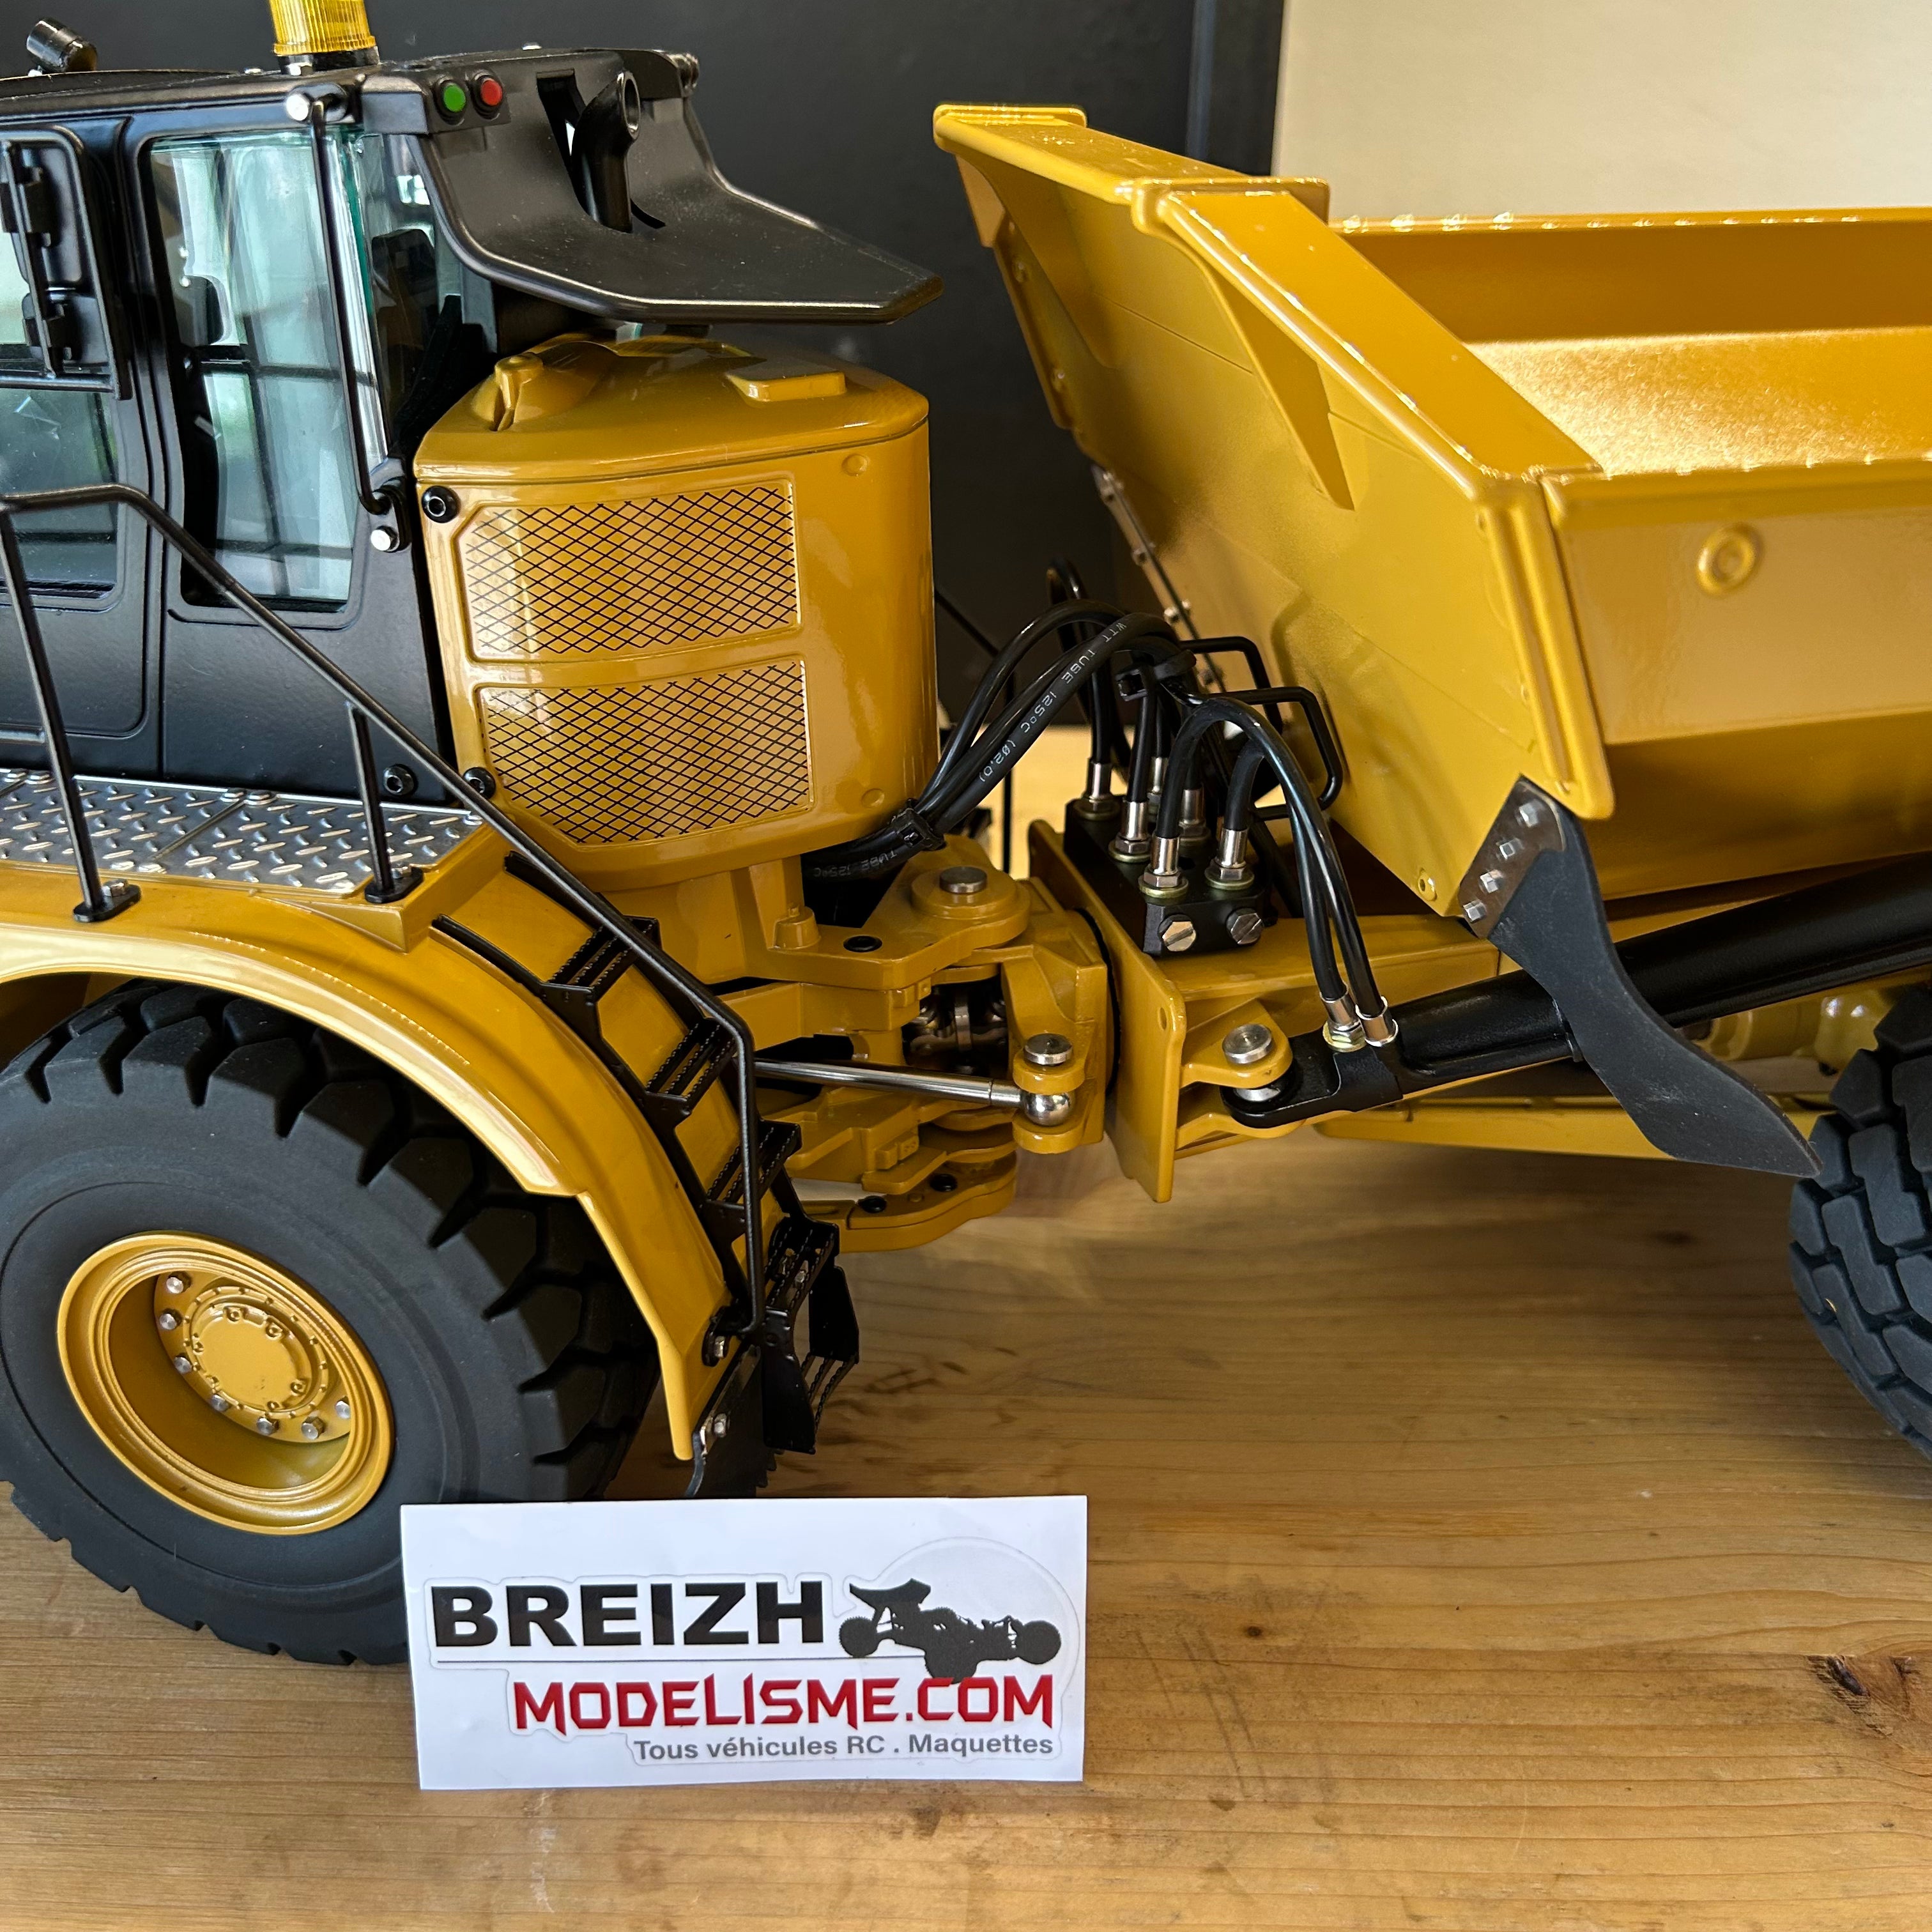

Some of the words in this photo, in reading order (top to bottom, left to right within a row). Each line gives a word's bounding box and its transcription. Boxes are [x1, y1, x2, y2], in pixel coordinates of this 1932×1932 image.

[1101, 622, 1127, 643] WTT
[1061, 649, 1096, 684] TUBE
[431, 1581, 824, 1647] BREIZH
[514, 1675, 1053, 1735] MODELISME.COM
[633, 1740, 698, 1760] Tous
[707, 1736, 838, 1758] véhicules
[847, 1735, 885, 1754] RC
[909, 1734, 1053, 1758] Maquettes
